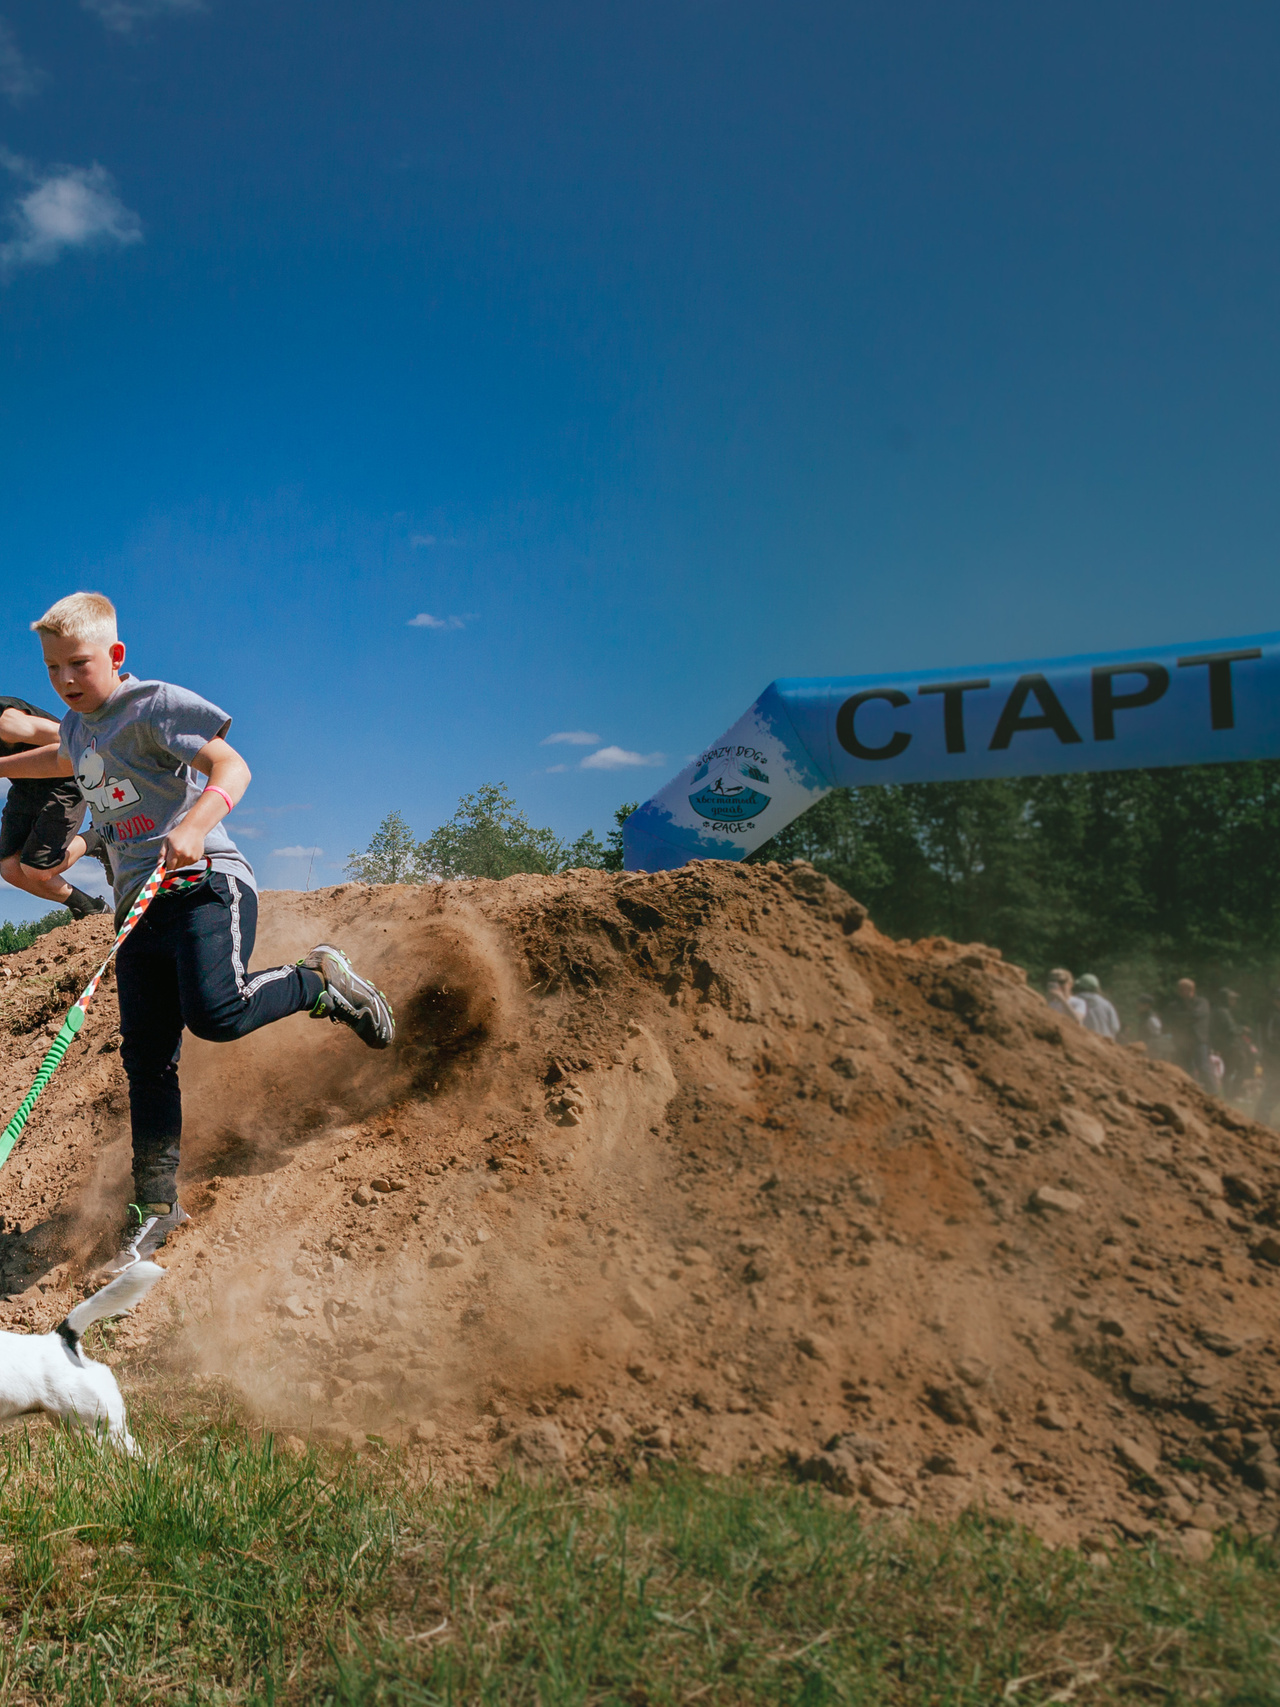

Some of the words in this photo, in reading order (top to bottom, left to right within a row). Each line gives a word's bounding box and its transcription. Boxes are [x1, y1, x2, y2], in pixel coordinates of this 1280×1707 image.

[835, 648, 1262, 761] СТАРТ
[702, 746, 731, 764] CRAZY
[736, 746, 763, 762] DOG
[116, 813, 155, 841] БУЛЬ
[712, 822, 748, 834] RACE
